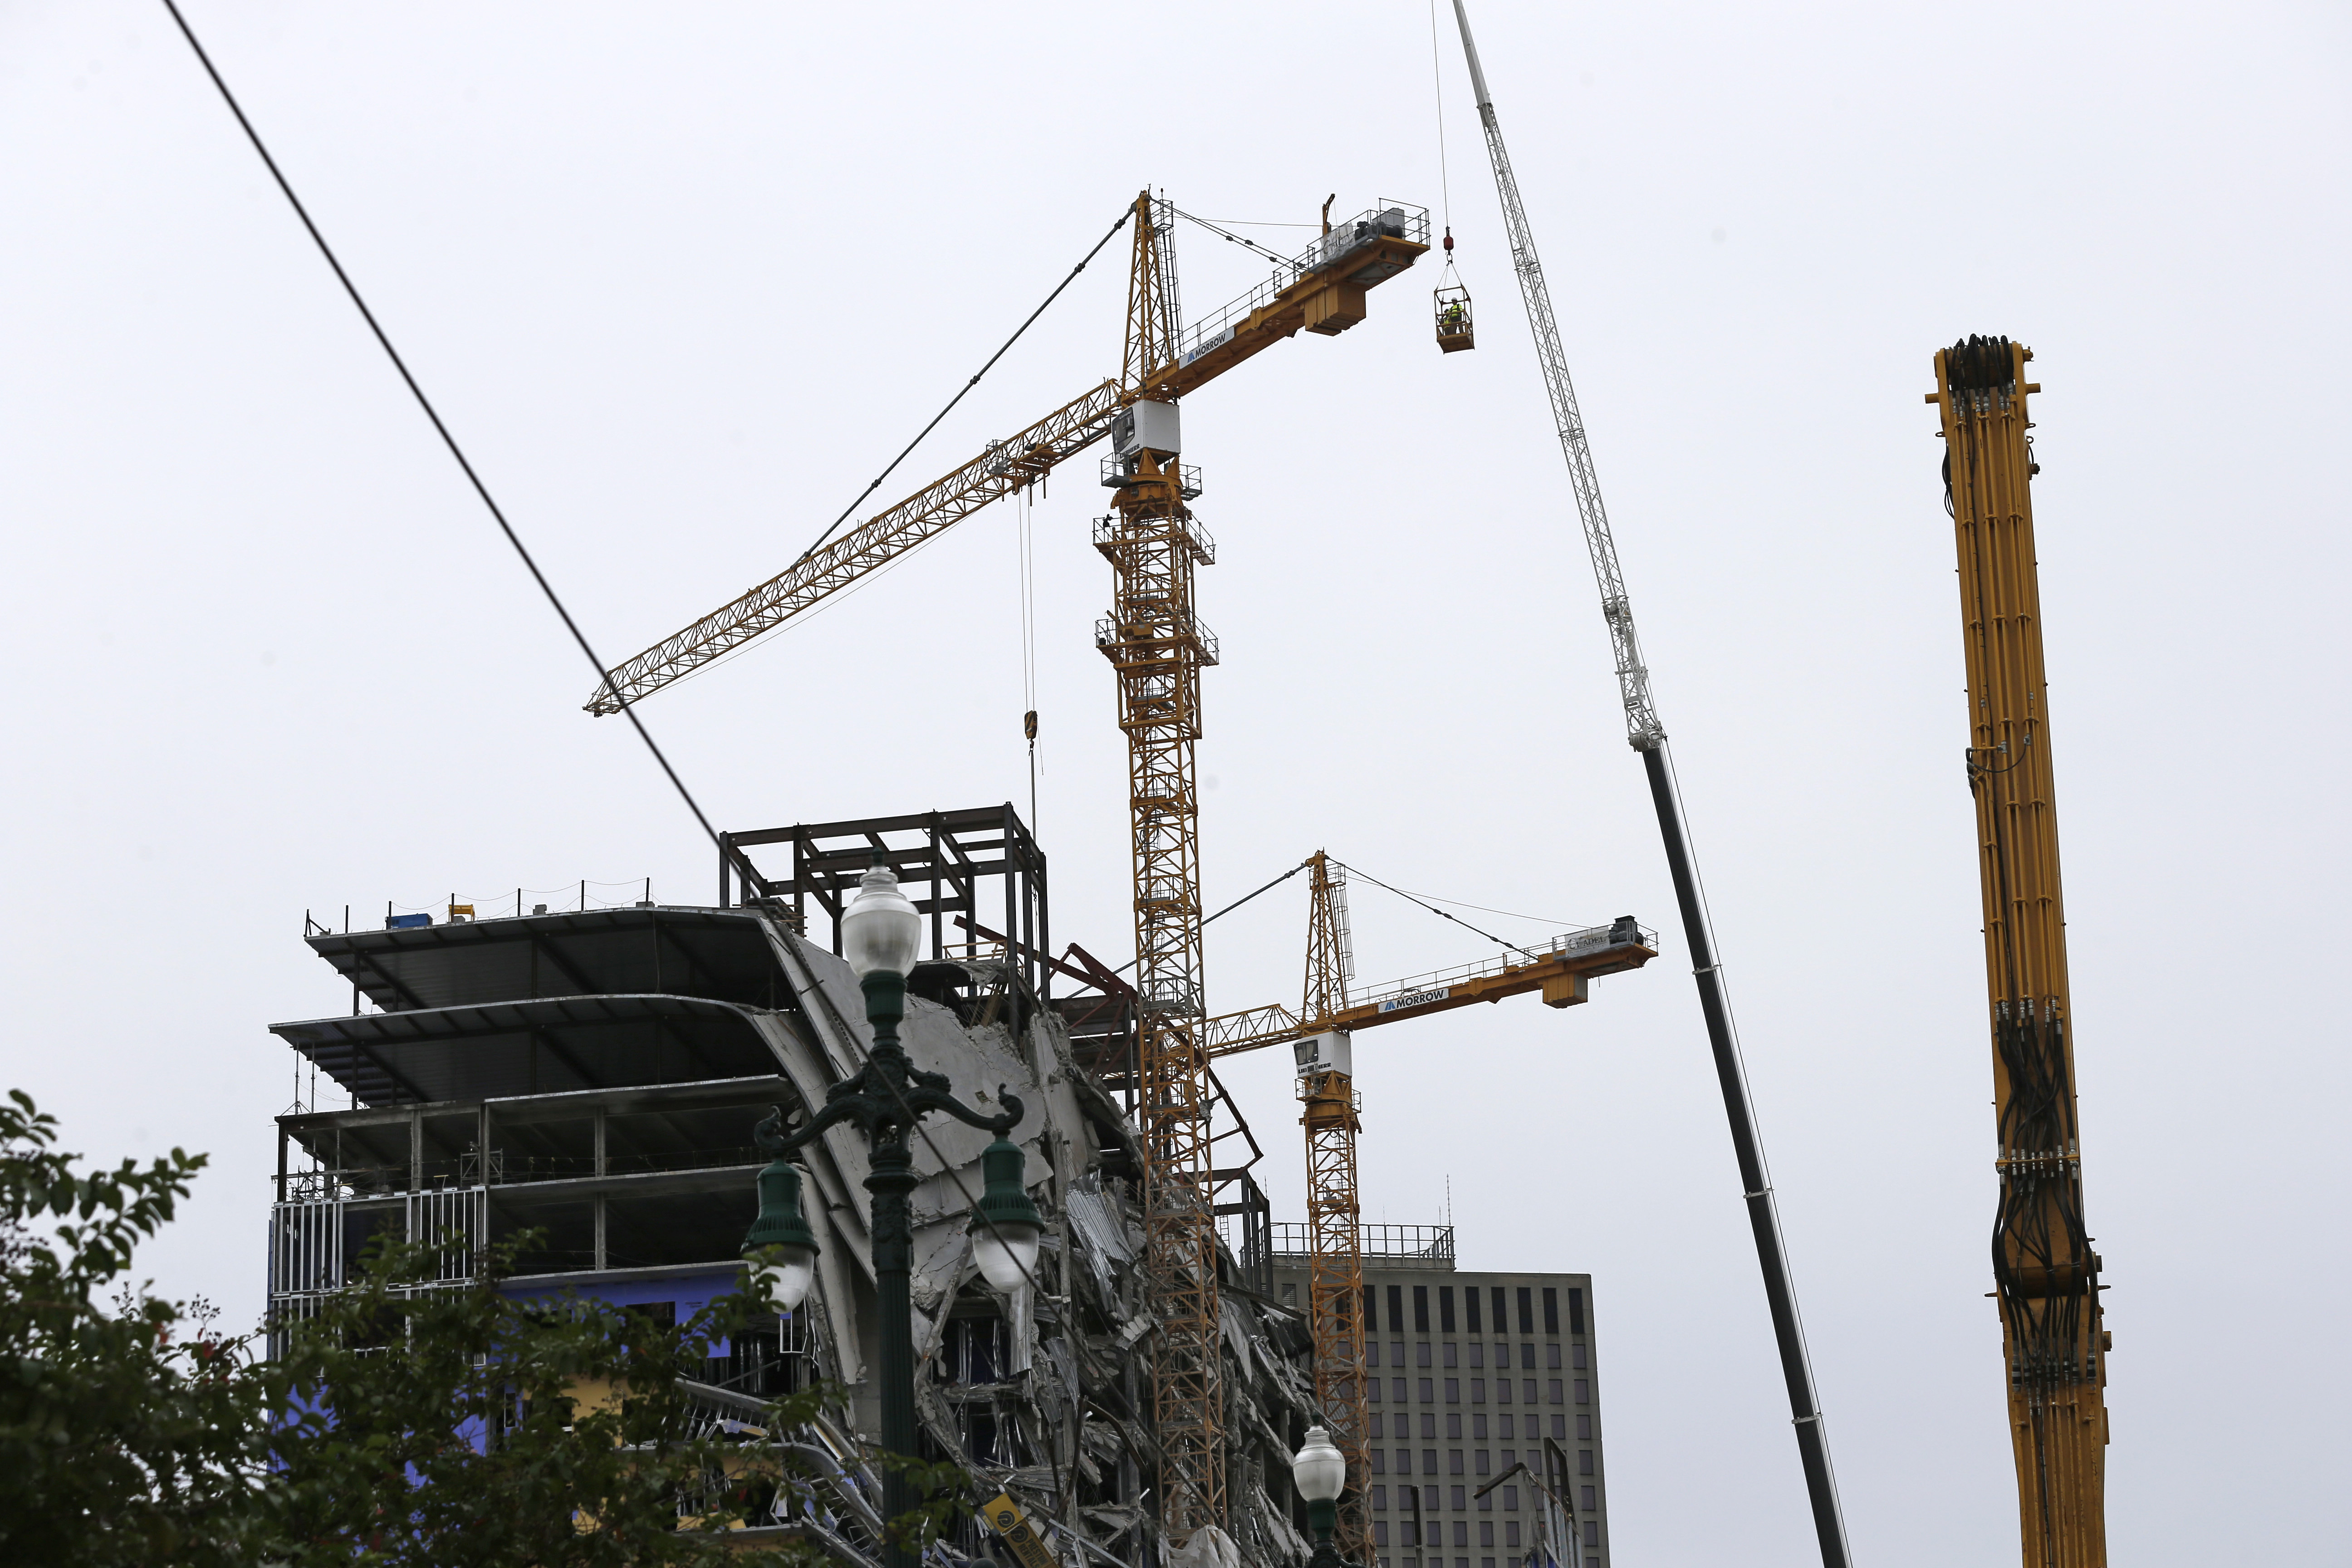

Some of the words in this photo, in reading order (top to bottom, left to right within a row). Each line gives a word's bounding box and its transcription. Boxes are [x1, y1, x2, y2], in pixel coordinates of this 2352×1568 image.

[1196, 333, 1225, 358] MORROW
[1396, 990, 1444, 1008] MORROW
[1298, 1062, 1331, 1074] LIEHERR
[1018, 1543, 1040, 1568] RENTALS
[1026, 1538, 1048, 1565] PRESTON
